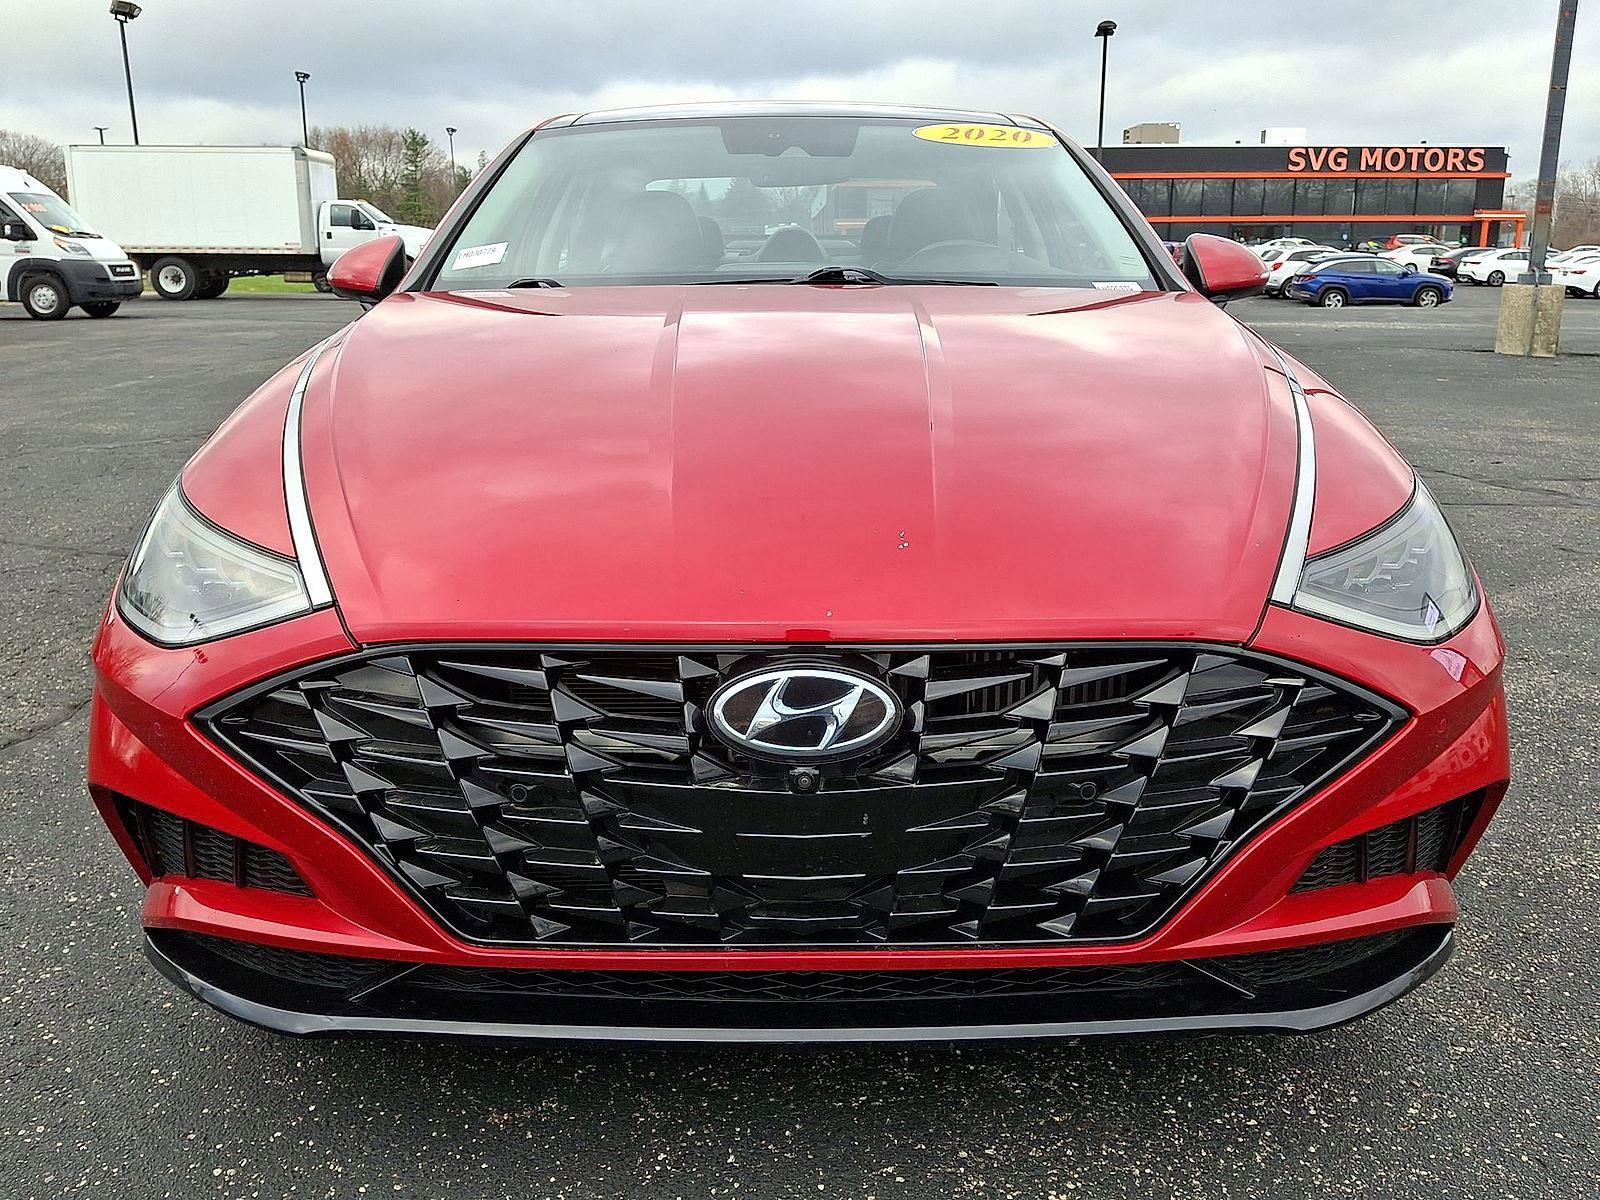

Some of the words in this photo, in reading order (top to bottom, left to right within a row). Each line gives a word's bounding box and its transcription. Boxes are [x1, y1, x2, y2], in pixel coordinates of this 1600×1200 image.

[941, 127, 1032, 143] 2020
[1287, 147, 1349, 172] SVG
[1359, 147, 1486, 172] MOTORS
